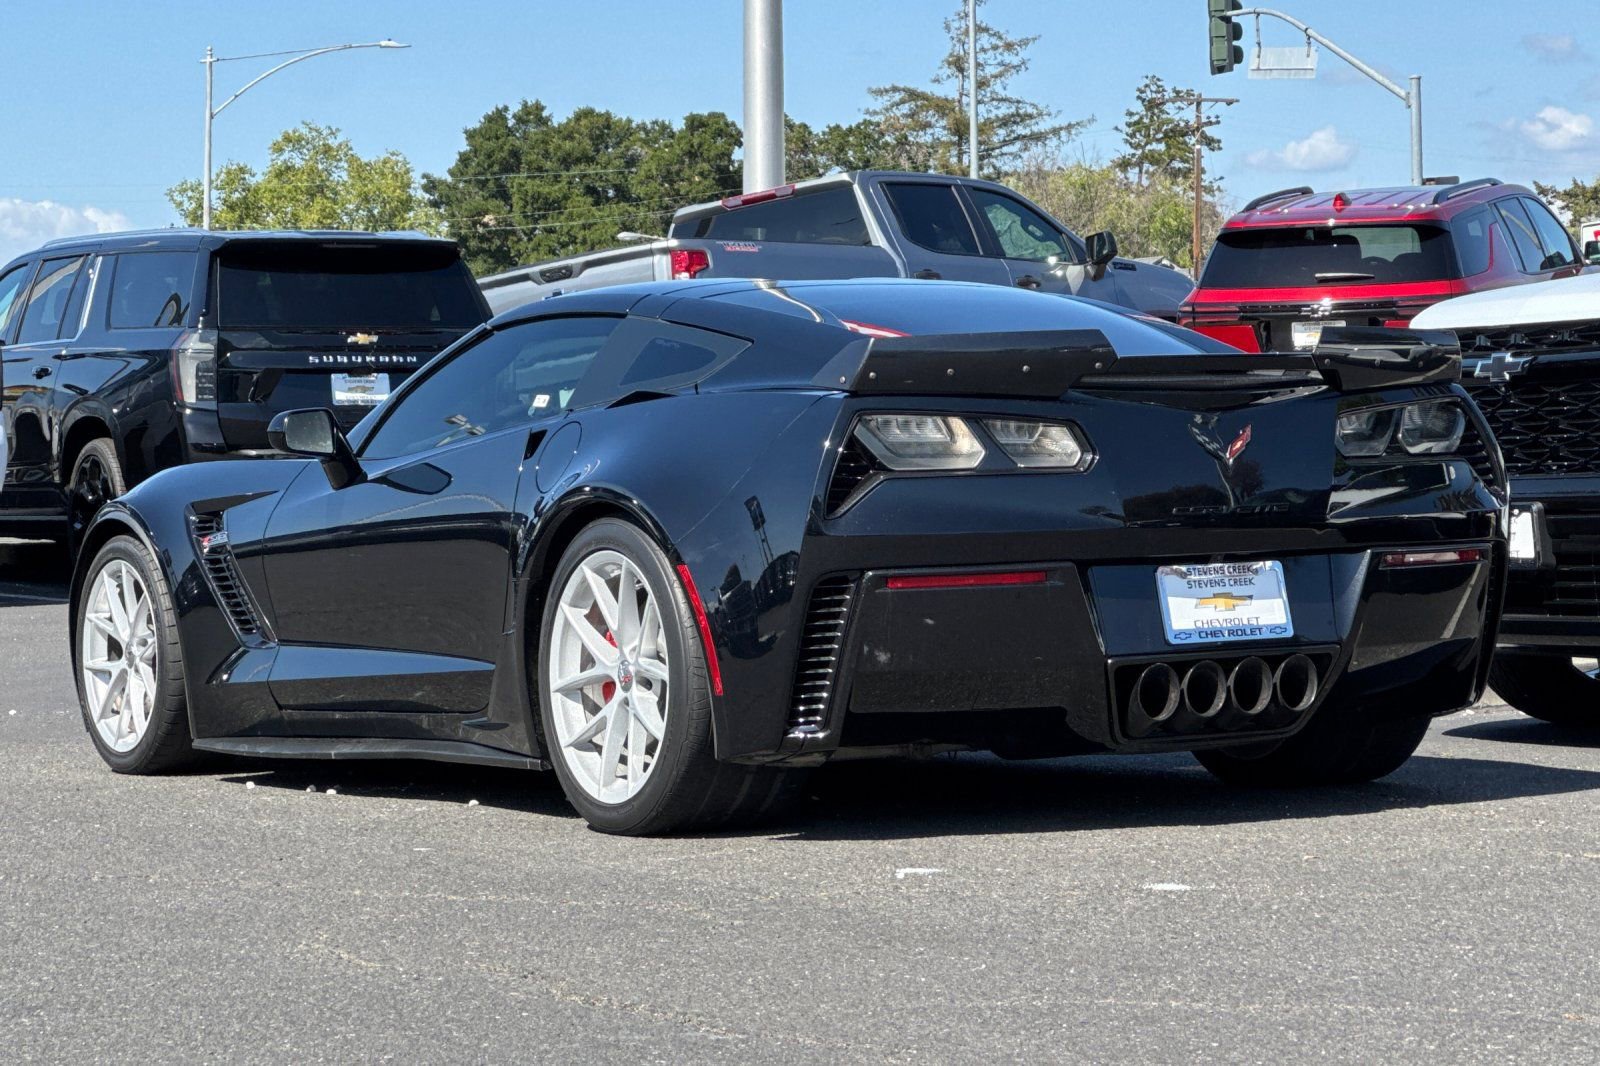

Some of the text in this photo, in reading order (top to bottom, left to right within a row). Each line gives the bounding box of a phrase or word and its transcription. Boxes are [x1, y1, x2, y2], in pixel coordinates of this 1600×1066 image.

[1187, 565, 1253, 577] STEVENS CREEK
[1187, 577, 1255, 589] STEVENS CREEK
[1194, 617, 1260, 628] CHEVROLET
[1198, 627, 1263, 638] CHEVROLET
